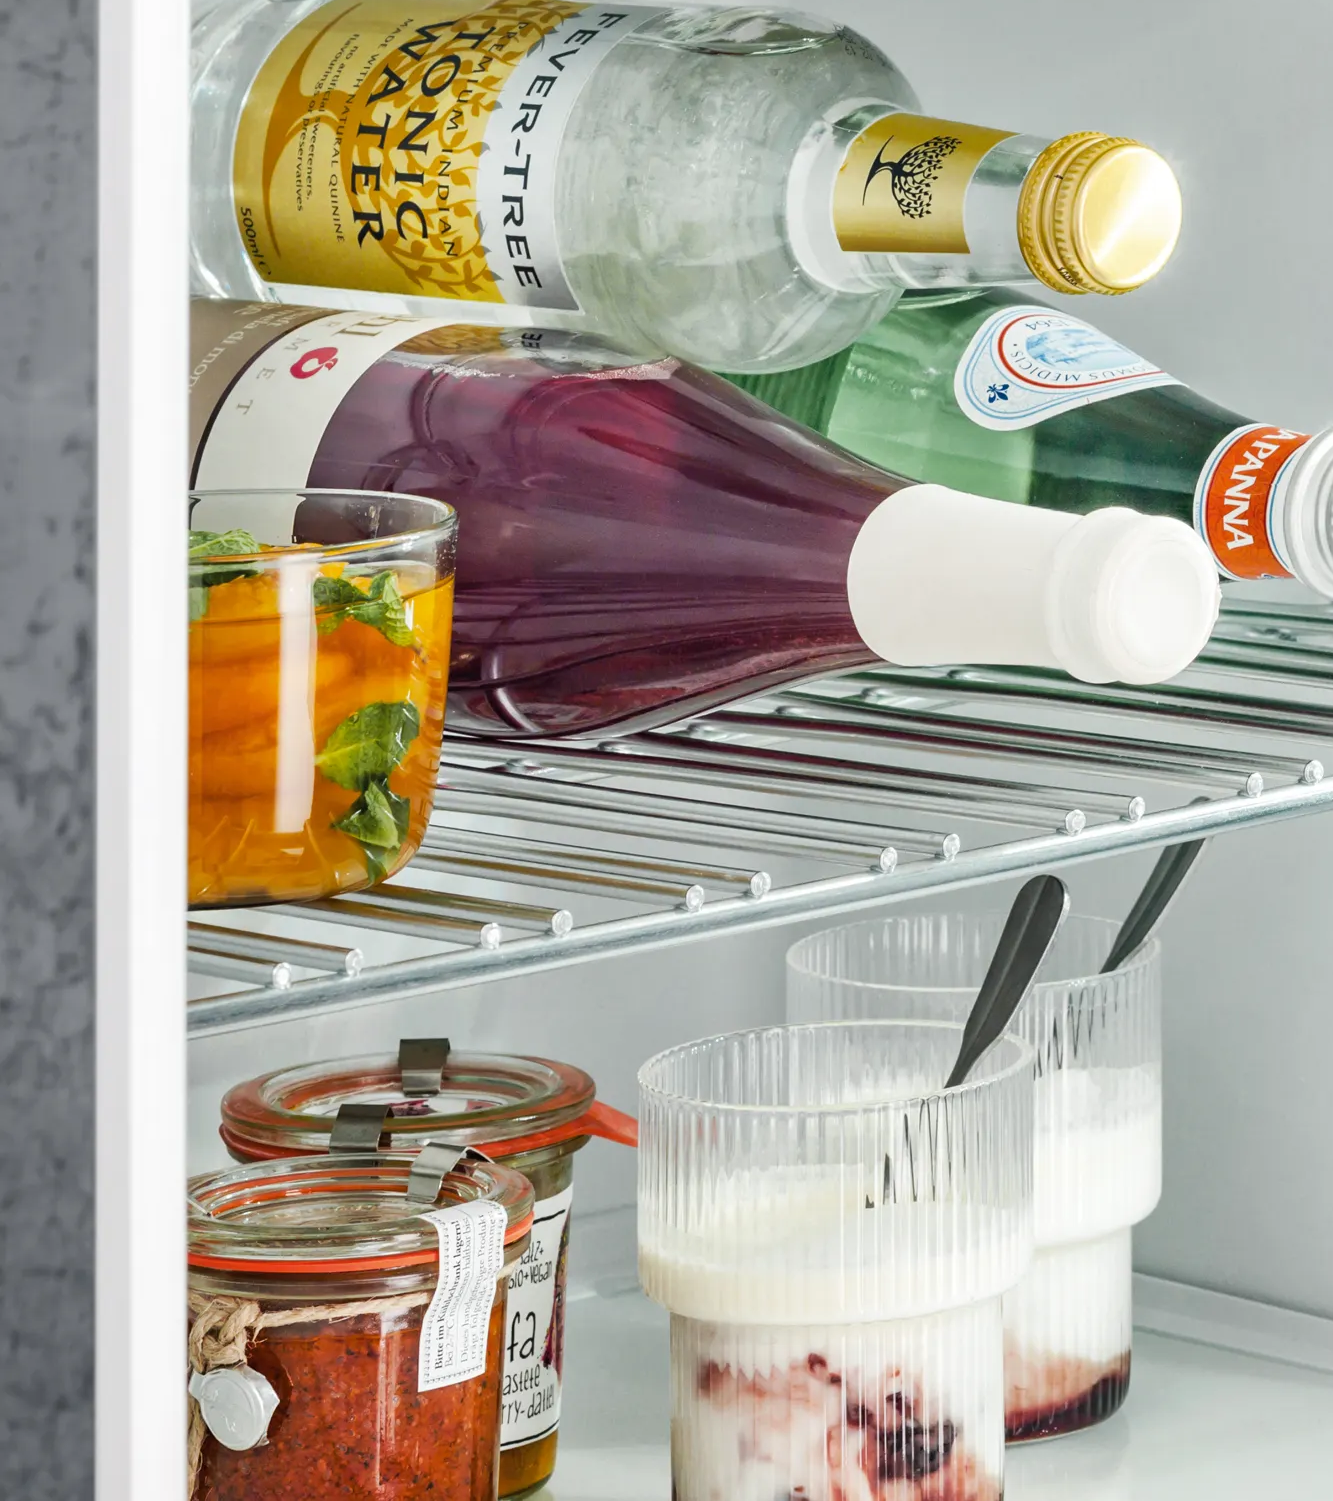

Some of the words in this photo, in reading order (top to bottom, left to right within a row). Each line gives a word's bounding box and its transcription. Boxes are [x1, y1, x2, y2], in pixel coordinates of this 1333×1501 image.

[378, 17, 414, 49] MADE
[353, 53, 379, 92] WITH
[446, 22, 528, 131] PREMIUM
[330, 93, 356, 169] NATURAL
[351, 19, 458, 248] WATER
[394, 26, 496, 241] TONIC
[501, 11, 629, 289] FEVER-TREE
[241, 206, 264, 258] 500ml
[327, 173, 345, 243] QUININE
[437, 149, 458, 257] INDIAN
[1010, 350, 1081, 383] MEDICIS
[1222, 439, 1281, 551] PANNA
[451, 1219, 463, 1259] lagern!
[434, 1341, 443, 1370] Bitte
[436, 1325, 444, 1340] im
